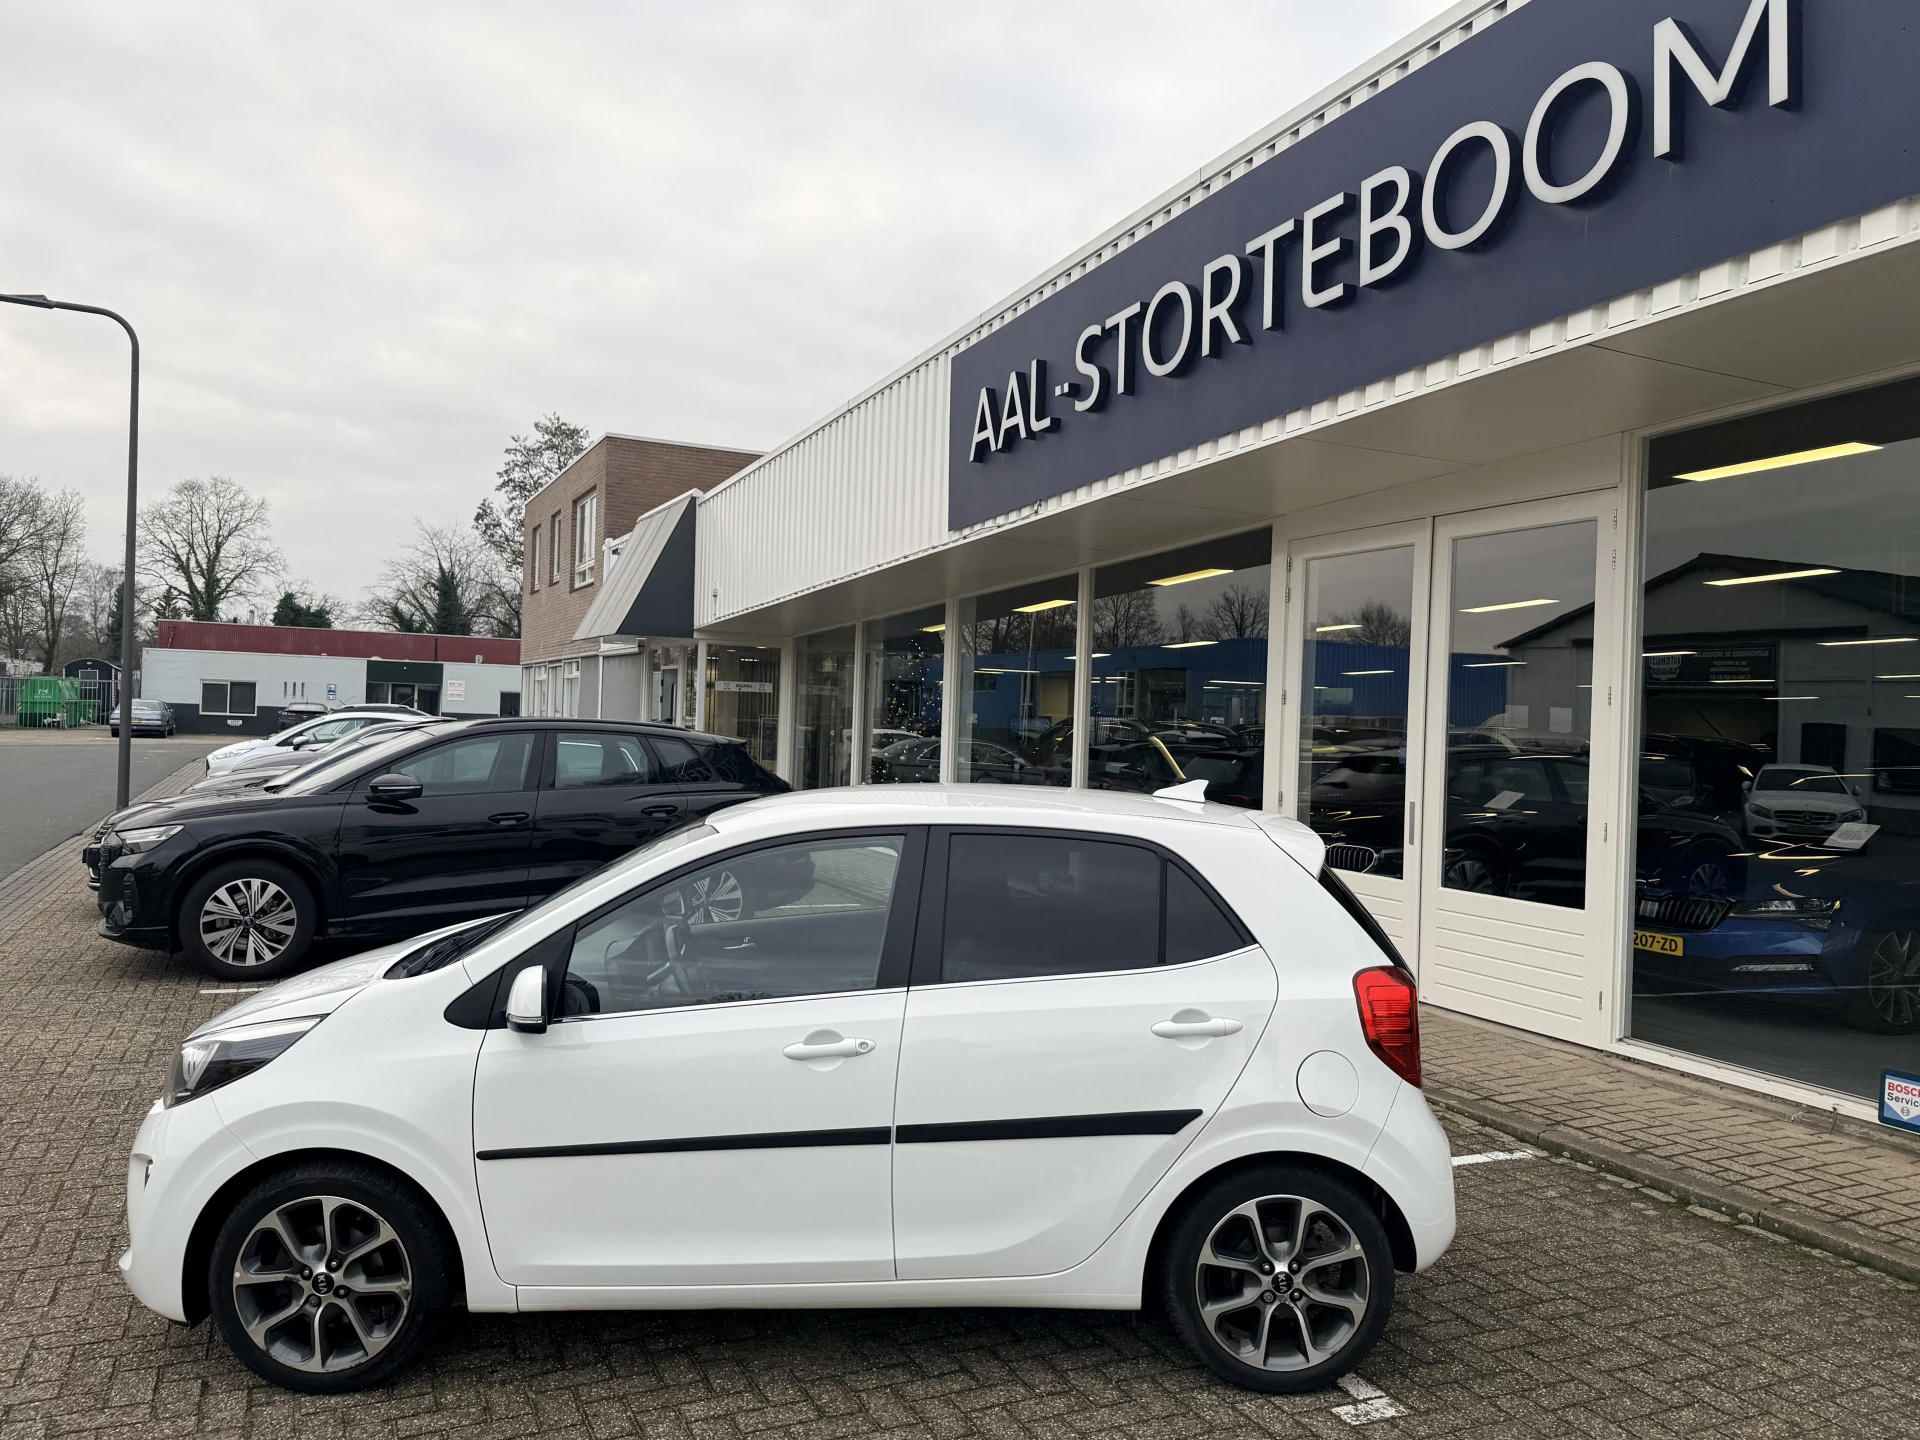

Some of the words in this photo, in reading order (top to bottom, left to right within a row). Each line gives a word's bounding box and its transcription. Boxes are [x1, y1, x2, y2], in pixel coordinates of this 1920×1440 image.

[1887, 1092, 1920, 1108] Servic
[317, 1274, 328, 1294] KIA
[1277, 1273, 1288, 1293] KIA
